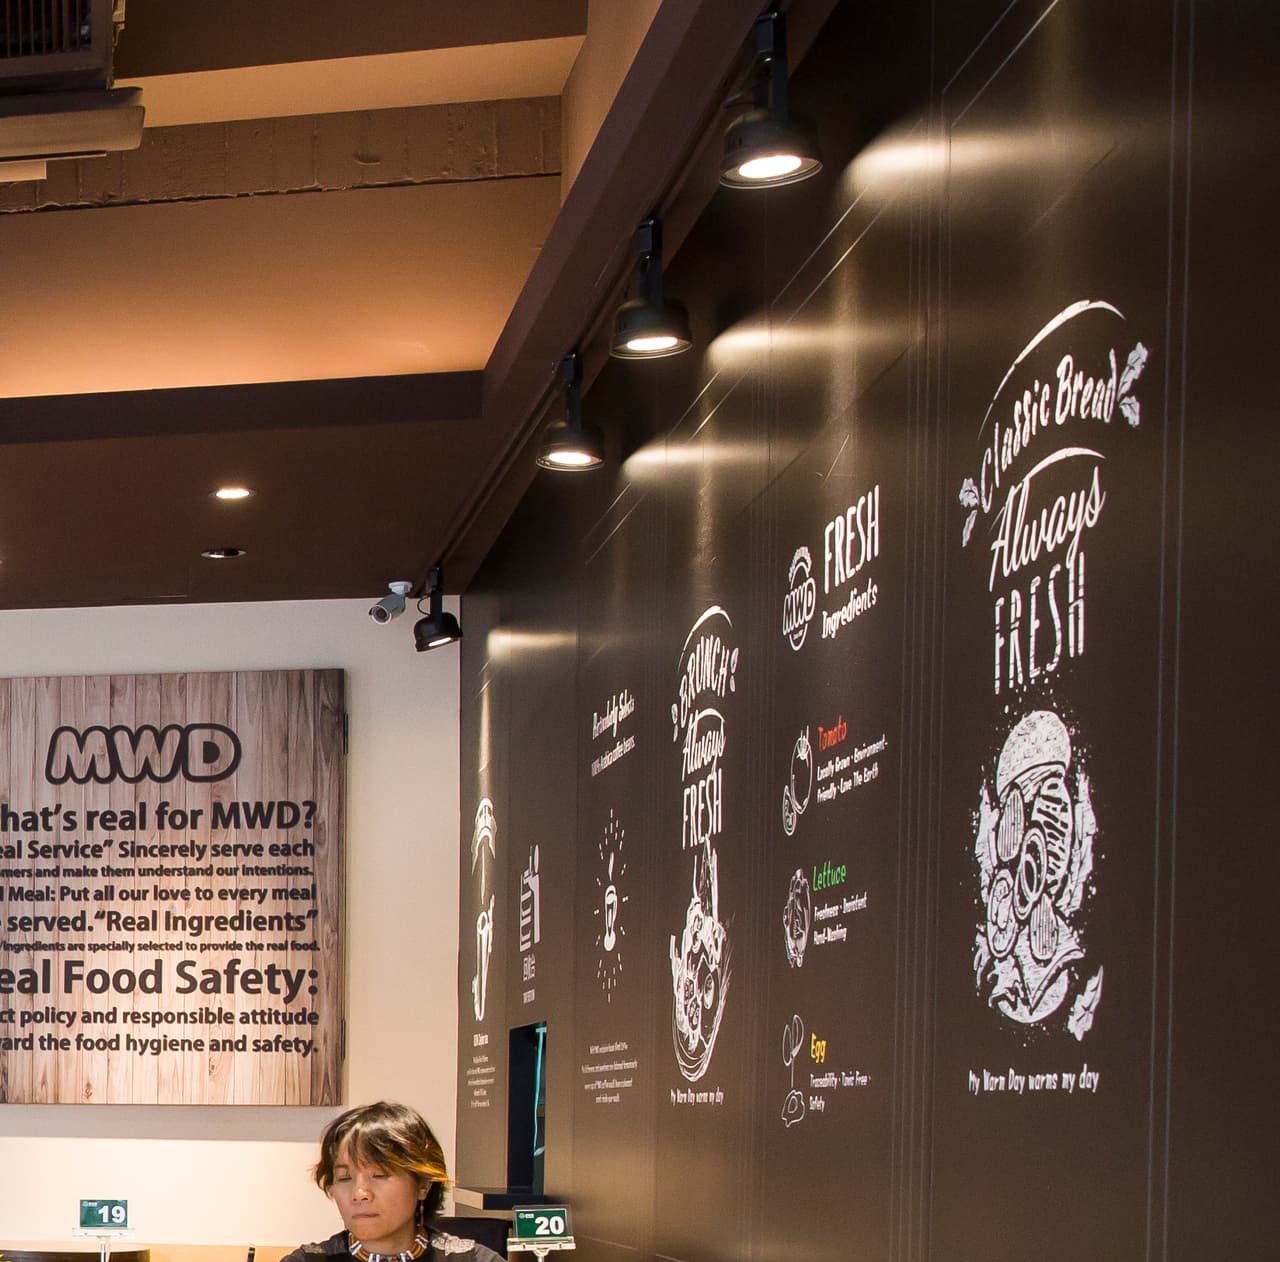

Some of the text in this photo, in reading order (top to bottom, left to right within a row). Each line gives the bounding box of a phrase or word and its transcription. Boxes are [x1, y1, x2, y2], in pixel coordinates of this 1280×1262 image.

[980, 348, 1119, 513] Classic Bread
[824, 484, 880, 594] FRESH
[989, 465, 1106, 592] Always
[782, 577, 816, 636] MWD
[821, 577, 878, 639] Ingredients
[994, 551, 1086, 695] FRESH
[679, 634, 730, 729] BRUNCH
[682, 709, 726, 782] Always
[818, 715, 847, 751] Tomato
[45, 722, 241, 785] MWD
[87, 801, 146, 831] real
[155, 802, 203, 830] for
[211, 799, 317, 829] MWD?
[682, 767, 723, 850] FRESH
[119, 840, 207, 861] Sincerely
[211, 844, 263, 857] serve
[269, 837, 315, 857] each
[9, 884, 55, 901] Meal:
[60, 886, 89, 901] Put
[94, 885, 114, 901] all
[119, 890, 149, 901] our
[154, 883, 190, 900] love
[195, 887, 213, 900] to
[218, 888, 267, 904] every
[272, 883, 316, 901] meal
[812, 860, 846, 891] Lettuce
[64, 959, 162, 993] Food
[176, 959, 318, 1003] Safety:
[21, 1007, 76, 1028] policy
[81, 1007, 117, 1023] and
[123, 1007, 234, 1028] responsible
[240, 1008, 319, 1025] attitude
[39, 1033, 70, 1051] the
[75, 1034, 120, 1050] food
[126, 1034, 204, 1056] hygiene
[209, 1035, 246, 1051] and
[253, 1035, 318, 1057] safety.
[811, 1032, 826, 1064] Egg
[1079, 1063, 1100, 1094] day
[98, 1205, 126, 1224] 19
[535, 1216, 564, 1235] 20
